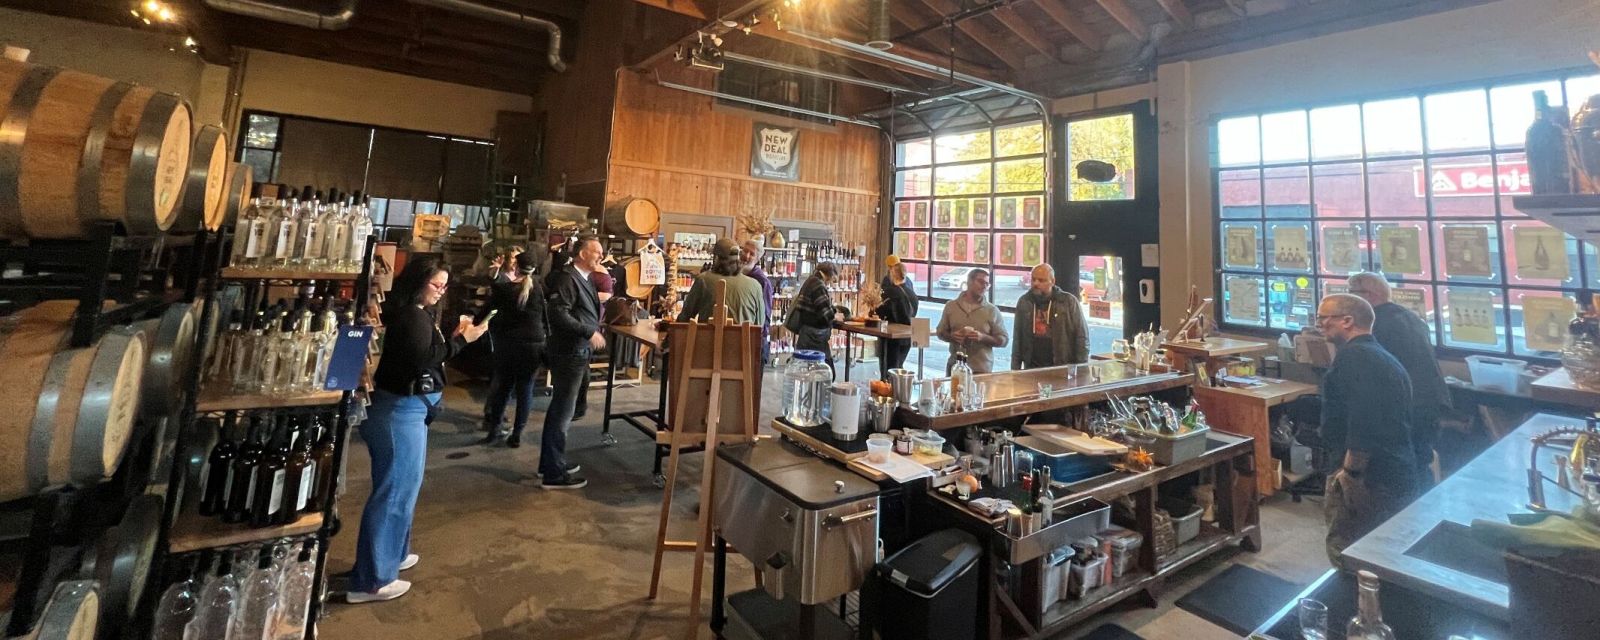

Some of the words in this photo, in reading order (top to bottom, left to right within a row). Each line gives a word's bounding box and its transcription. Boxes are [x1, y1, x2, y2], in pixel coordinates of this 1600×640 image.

[765, 134, 788, 145] NEW
[764, 144, 788, 155] DEAL
[347, 330, 364, 338] GIN
